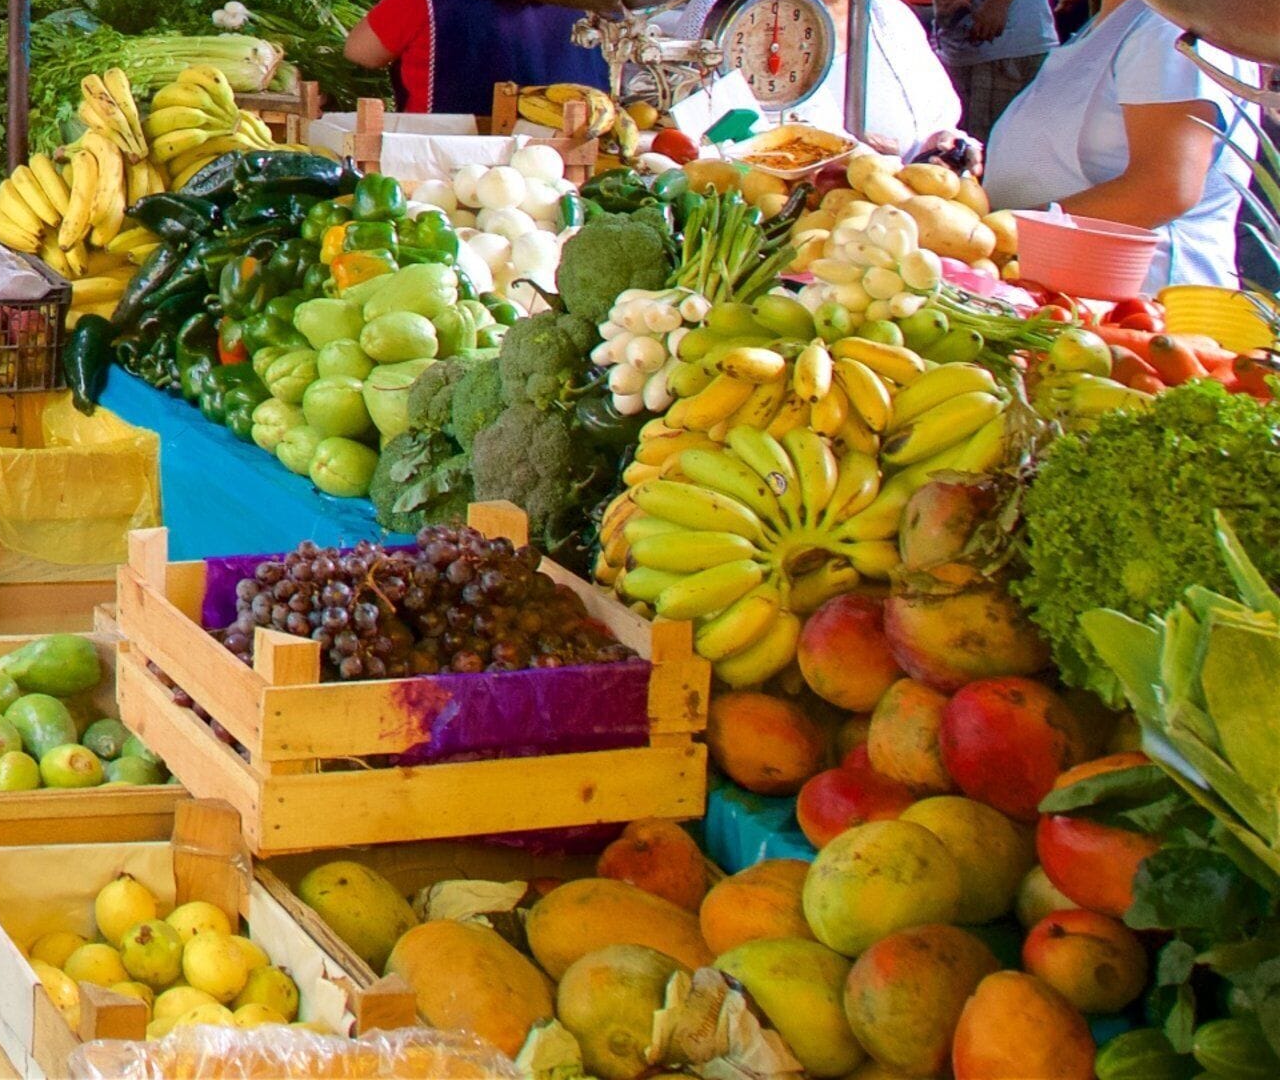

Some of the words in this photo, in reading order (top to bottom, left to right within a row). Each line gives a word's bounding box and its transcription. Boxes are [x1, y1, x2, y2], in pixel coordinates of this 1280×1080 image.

[749, 12, 755, 24] 1
[793, 9, 801, 21] 9
[736, 32, 744, 44] 2
[804, 27, 812, 40] 8
[735, 56, 742, 68] 3
[804, 52, 811, 64] 7
[748, 74, 755, 85] 4
[789, 71, 797, 82] 6
[768, 80, 776, 92] 5
